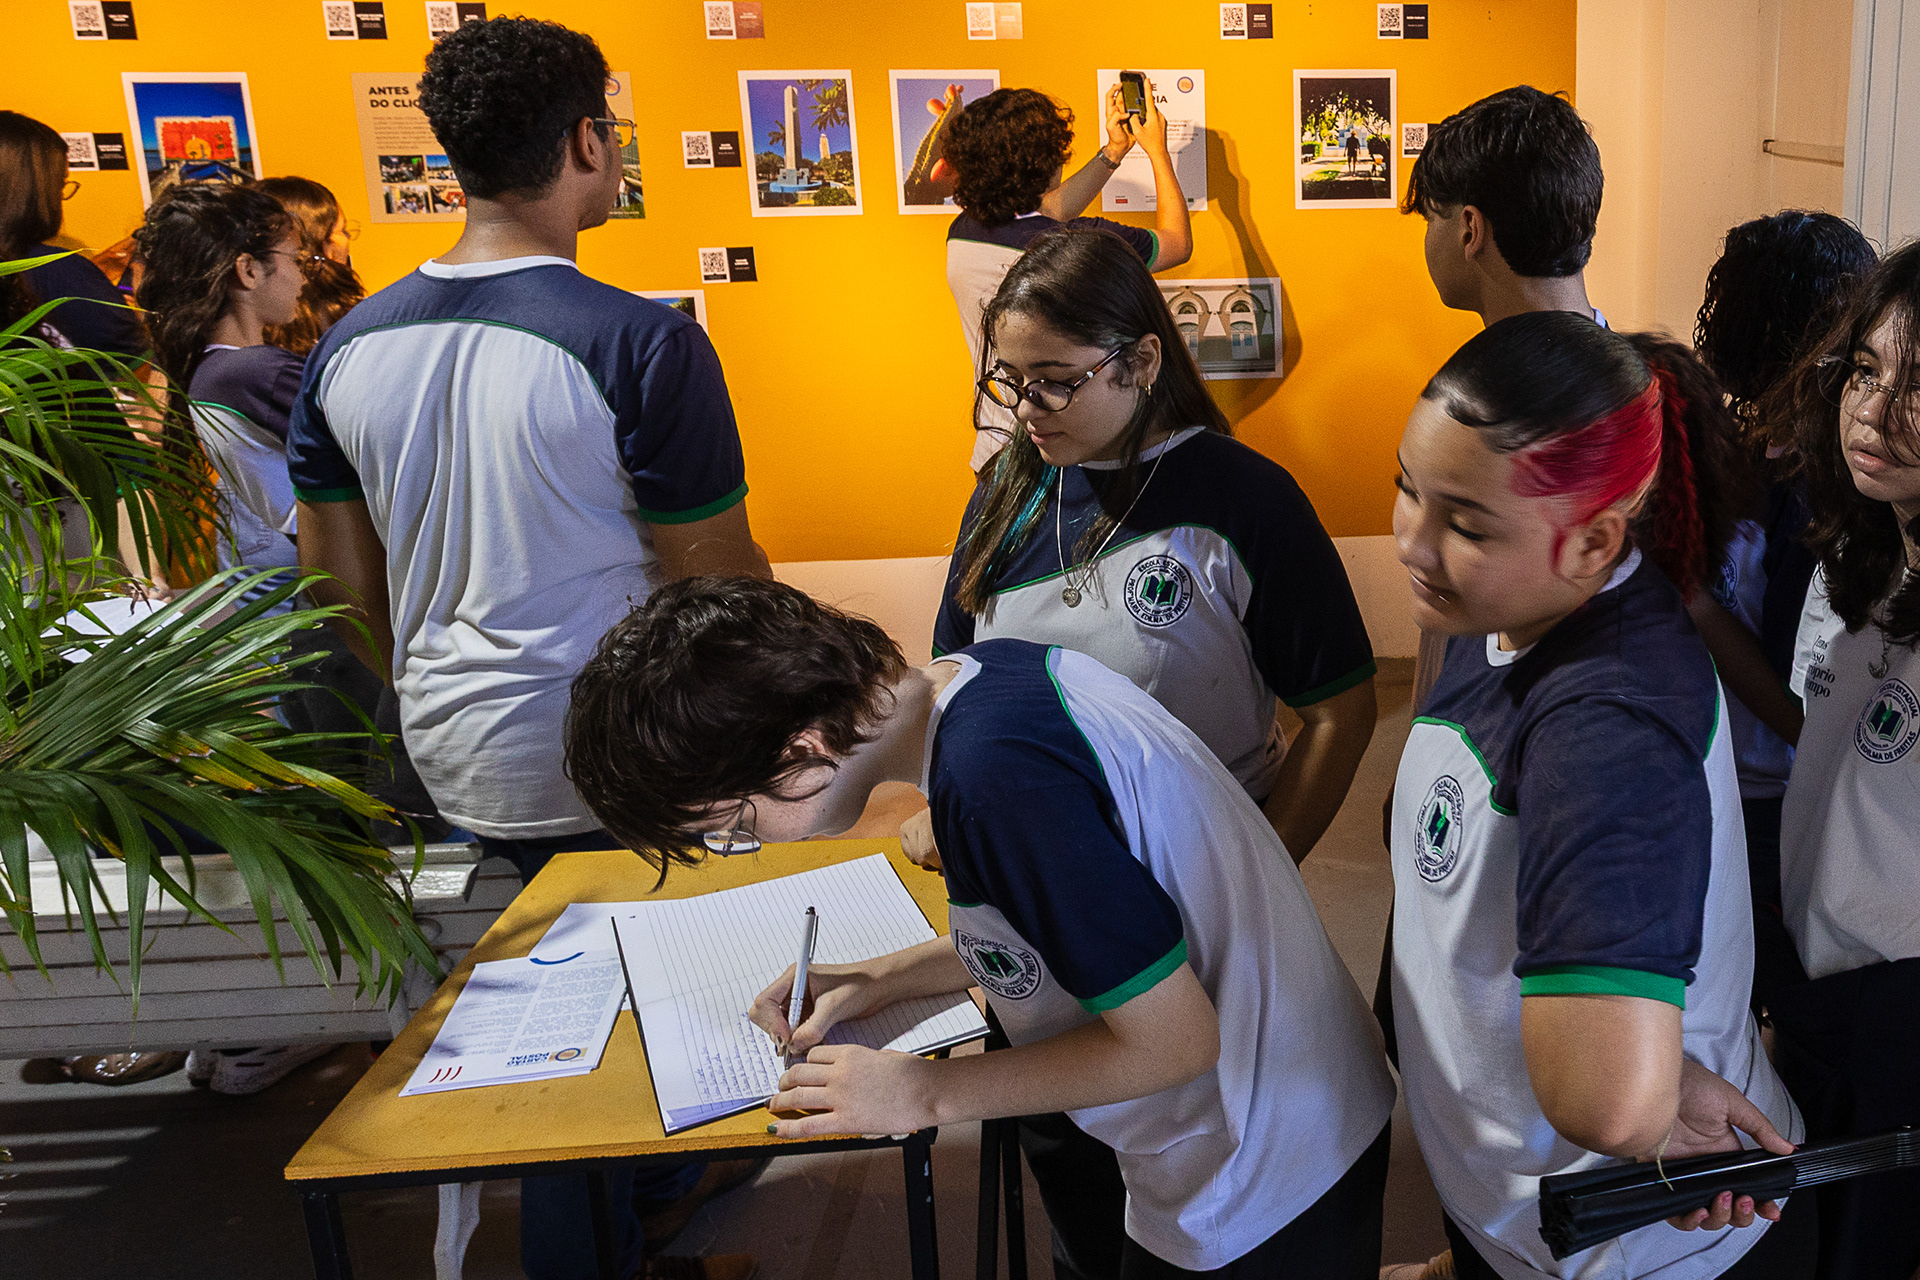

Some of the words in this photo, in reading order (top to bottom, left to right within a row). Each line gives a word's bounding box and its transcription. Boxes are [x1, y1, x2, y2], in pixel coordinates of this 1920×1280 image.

[369, 86, 409, 95] ANTES
[370, 99, 389, 108] DO
[1138, 560, 1160, 572] ESCOLA
[1162, 560, 1189, 584] ESTADUAL
[1127, 596, 1140, 615] MARIA
[1165, 612, 1175, 620] DE
[1895, 684, 1918, 719] ESTADUAL
[1860, 743, 1883, 760] EDILMA
[1884, 751, 1894, 760] DE
[1894, 731, 1916, 757] FREITAS
